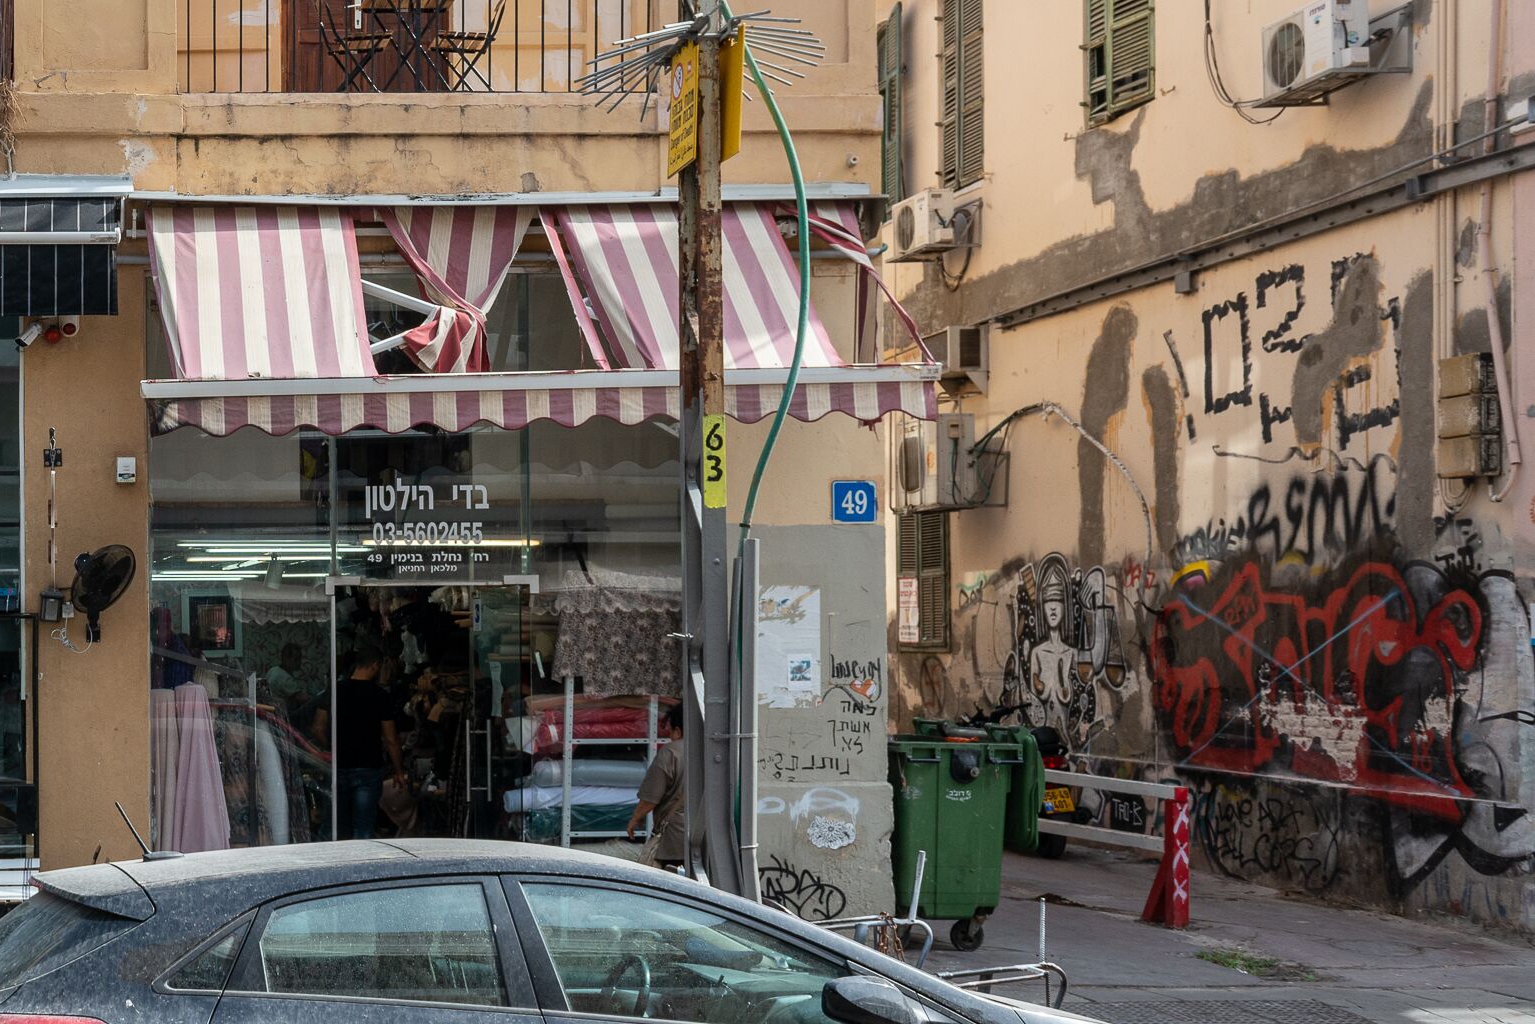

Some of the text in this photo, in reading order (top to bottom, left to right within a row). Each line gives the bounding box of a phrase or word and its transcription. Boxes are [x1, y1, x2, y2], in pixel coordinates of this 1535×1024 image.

[365, 478, 490, 519] בדי הילטון
[841, 489, 867, 515] 49
[372, 521, 483, 545] 03-5602455
[367, 554, 383, 563] 49
[391, 553, 423, 565] בנימין
[431, 551, 462, 562] נחלת
